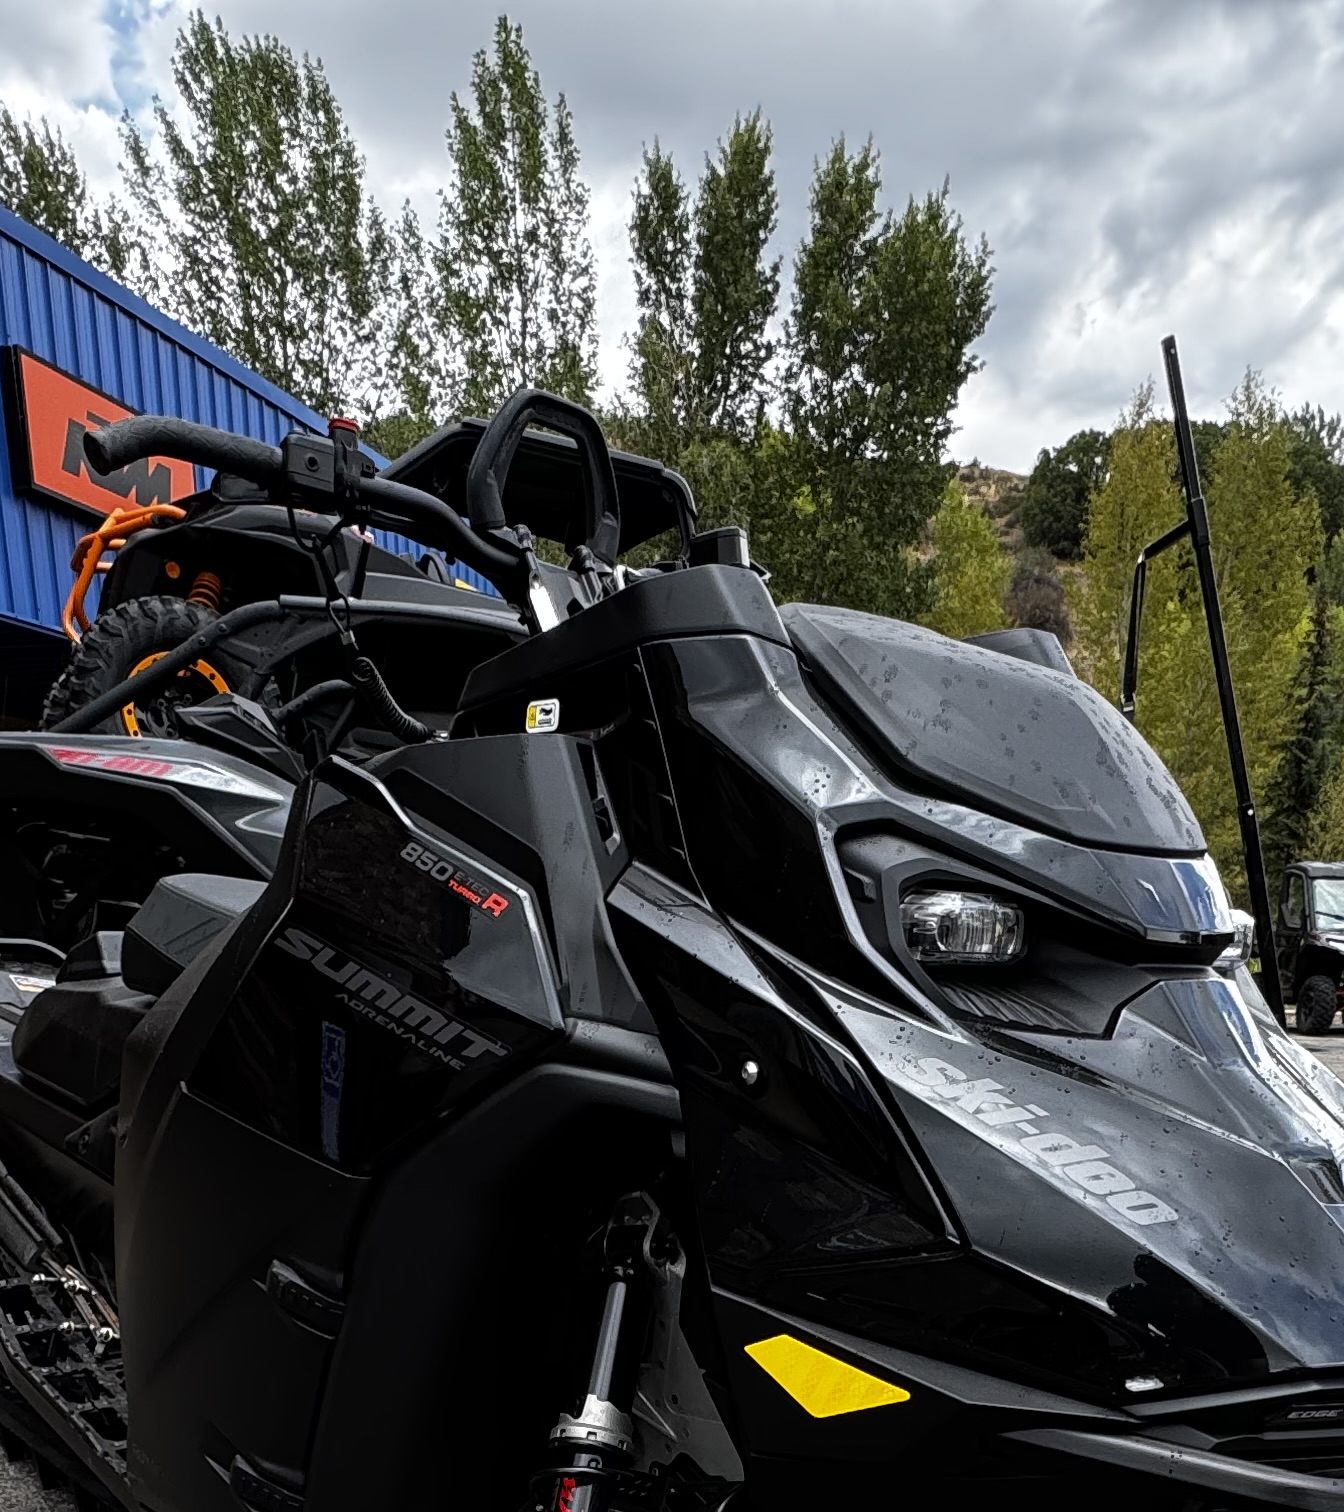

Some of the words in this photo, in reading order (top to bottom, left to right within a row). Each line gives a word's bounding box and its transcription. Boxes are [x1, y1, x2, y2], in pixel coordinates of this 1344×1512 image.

[400, 842, 454, 881] 850
[453, 871, 490, 897] E-TEC
[448, 879, 481, 904] TURBO
[482, 892, 509, 918] R
[274, 928, 508, 1058] SUMMIT
[335, 993, 466, 1071] ADRENALINE
